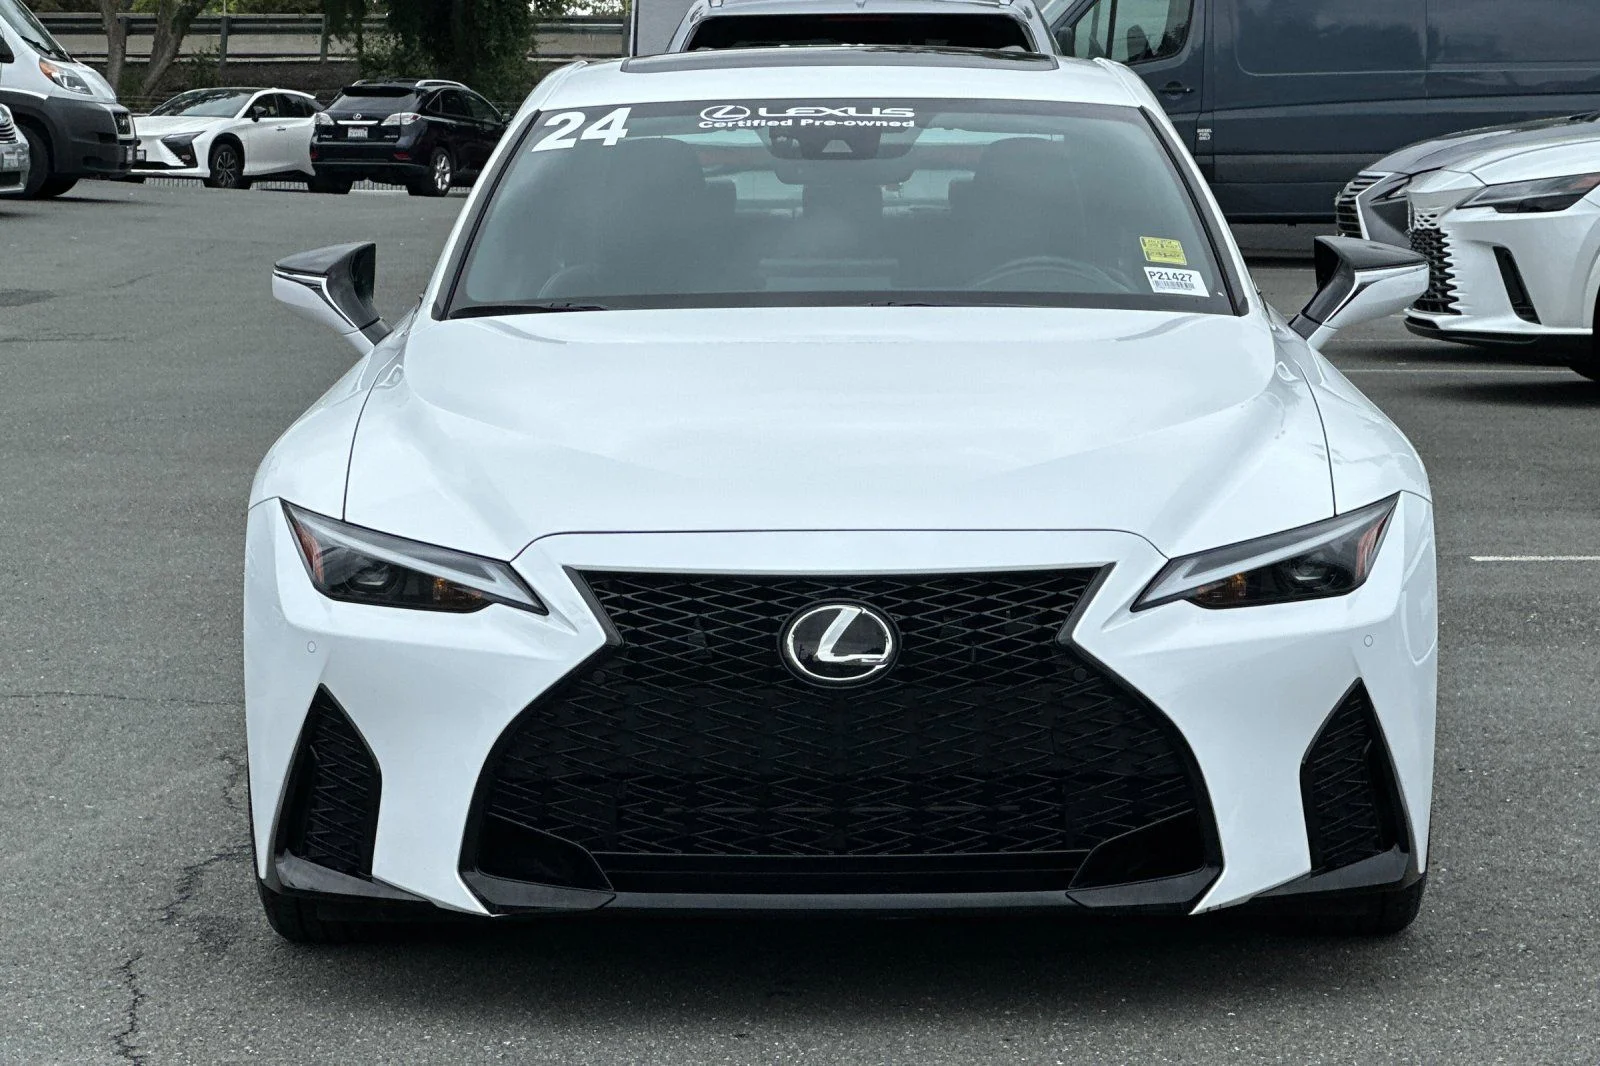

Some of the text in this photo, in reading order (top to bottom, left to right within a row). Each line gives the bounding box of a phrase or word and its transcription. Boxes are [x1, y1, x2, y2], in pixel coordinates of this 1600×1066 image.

[758, 106, 915, 118] LEXUS
[699, 118, 915, 128] Certified Pre-owned
[531, 107, 632, 153] 24
[1148, 270, 1193, 282] P21427
